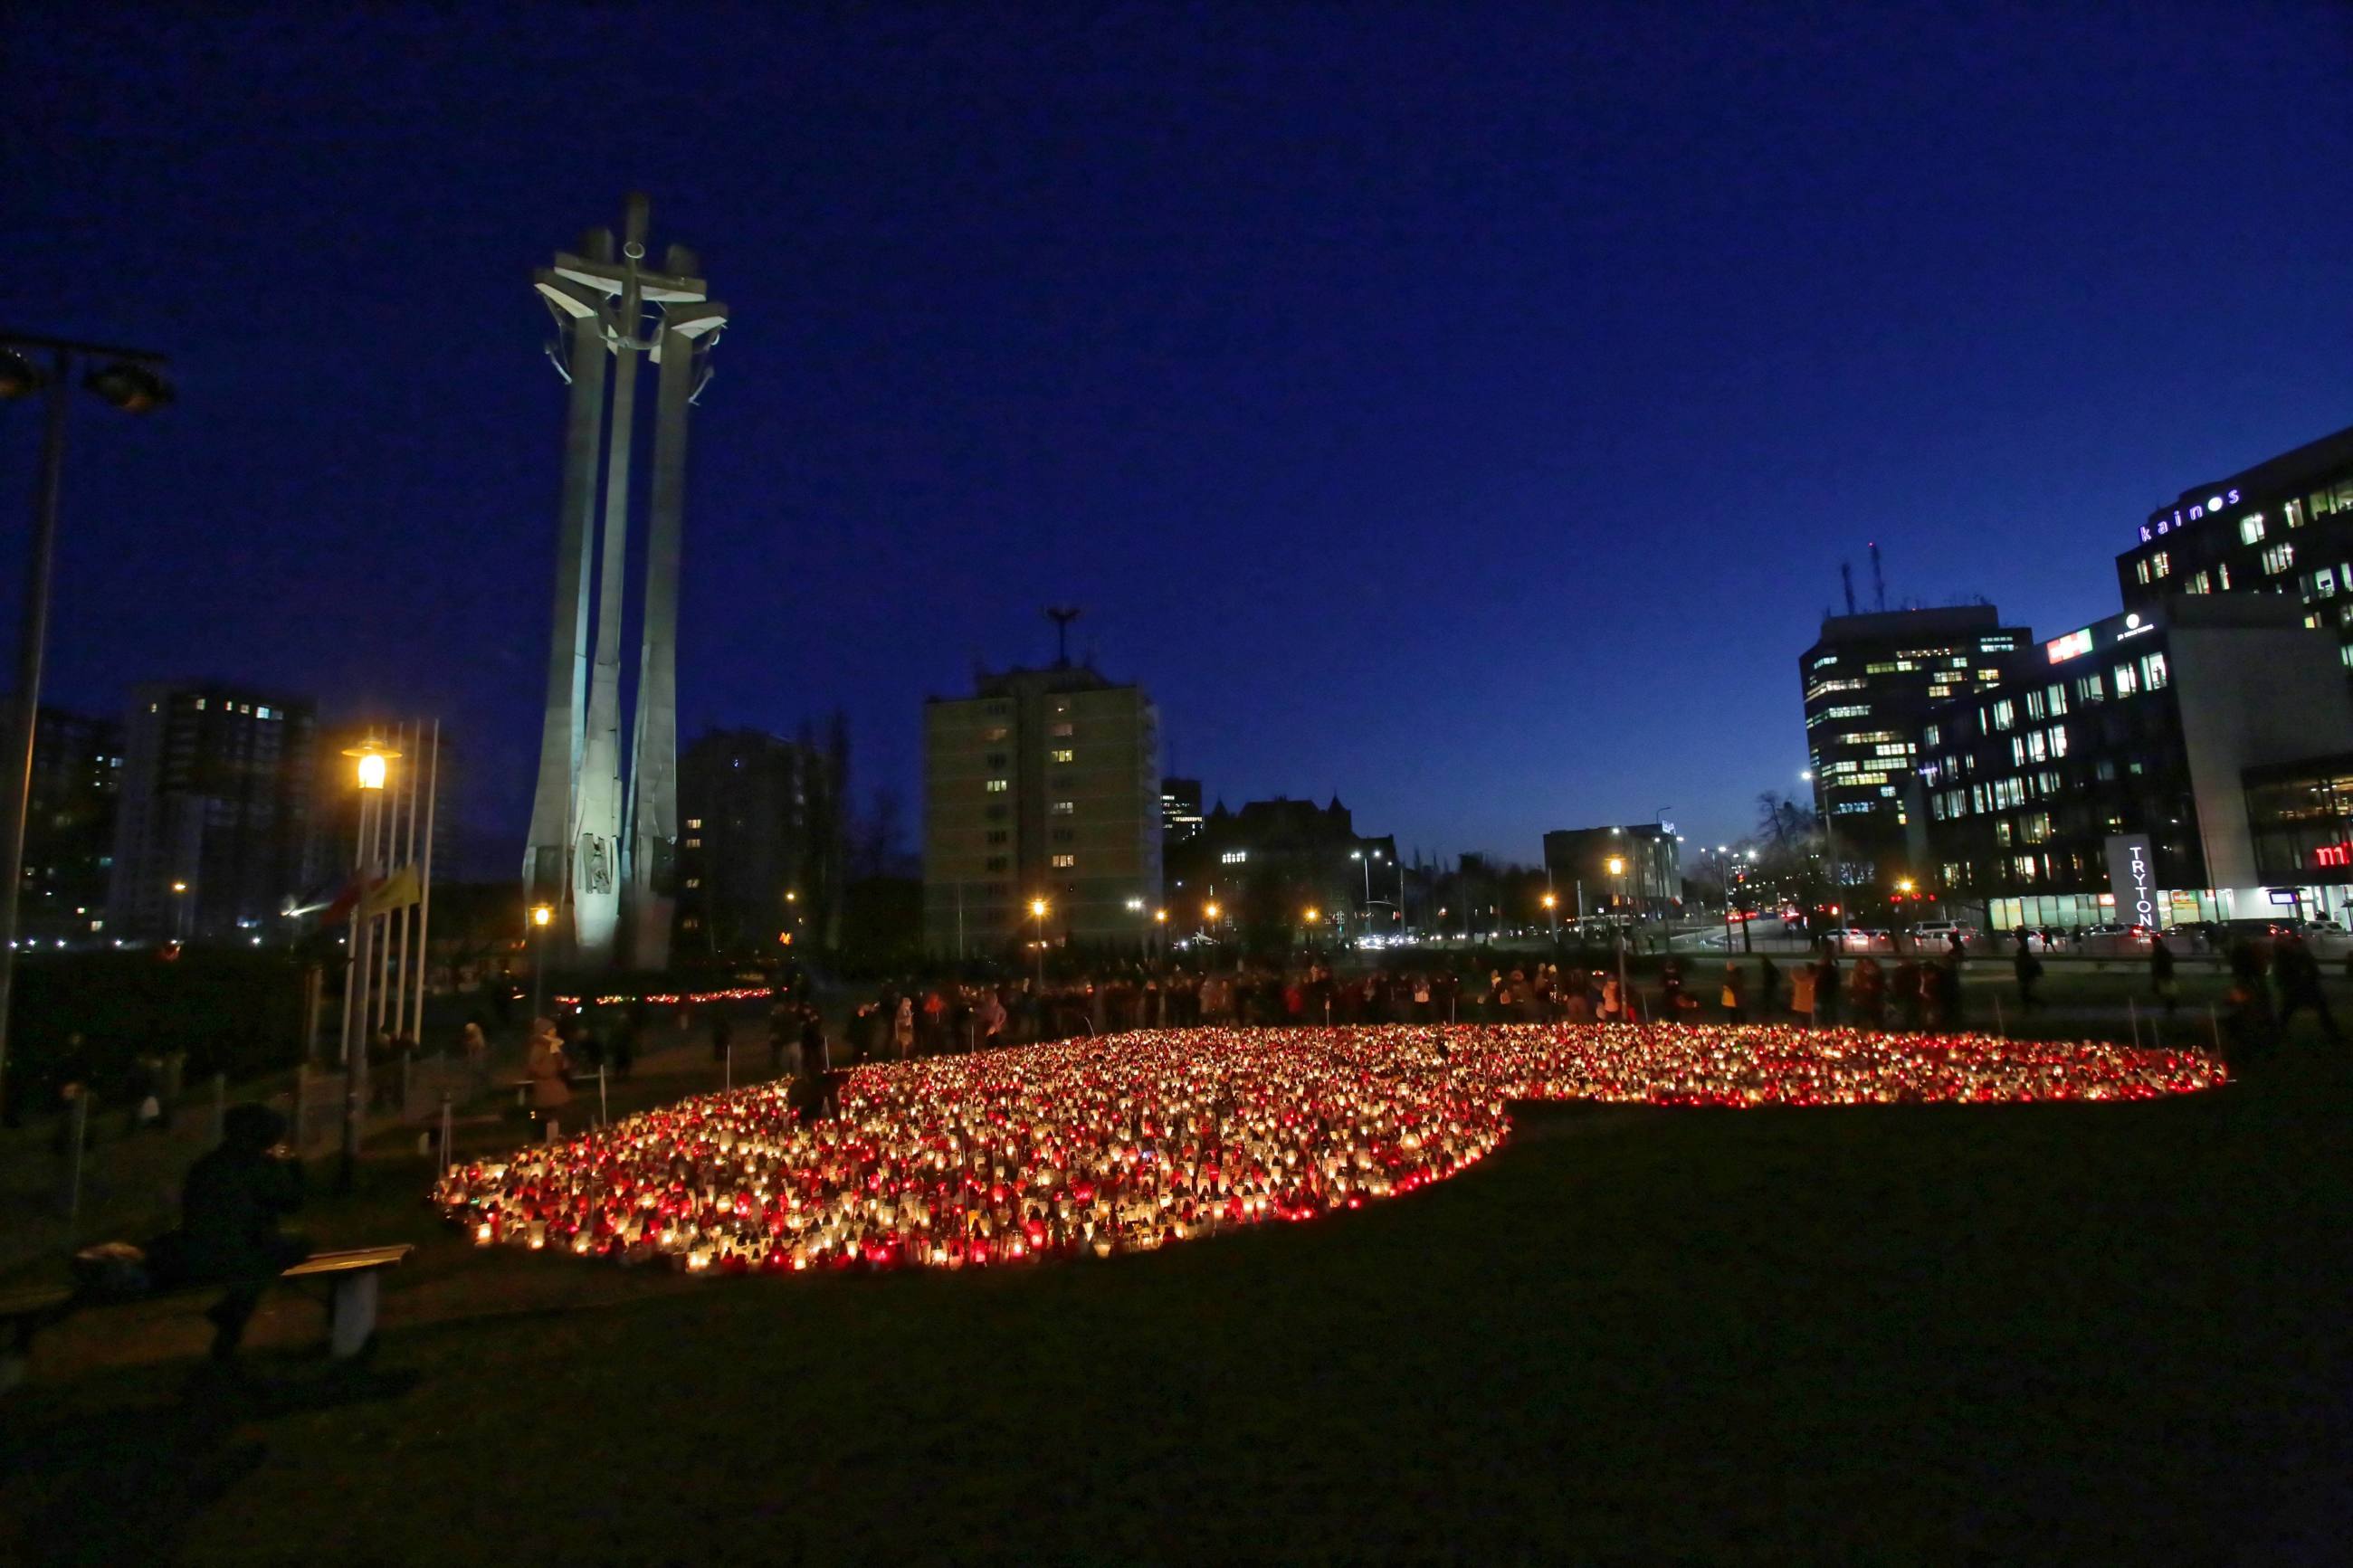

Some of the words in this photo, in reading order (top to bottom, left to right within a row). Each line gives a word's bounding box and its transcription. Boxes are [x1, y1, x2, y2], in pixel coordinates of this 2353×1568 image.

[2139, 489, 2240, 543] kainos
[2316, 841, 2352, 866] m
[2129, 846, 2153, 927] TRYTON
